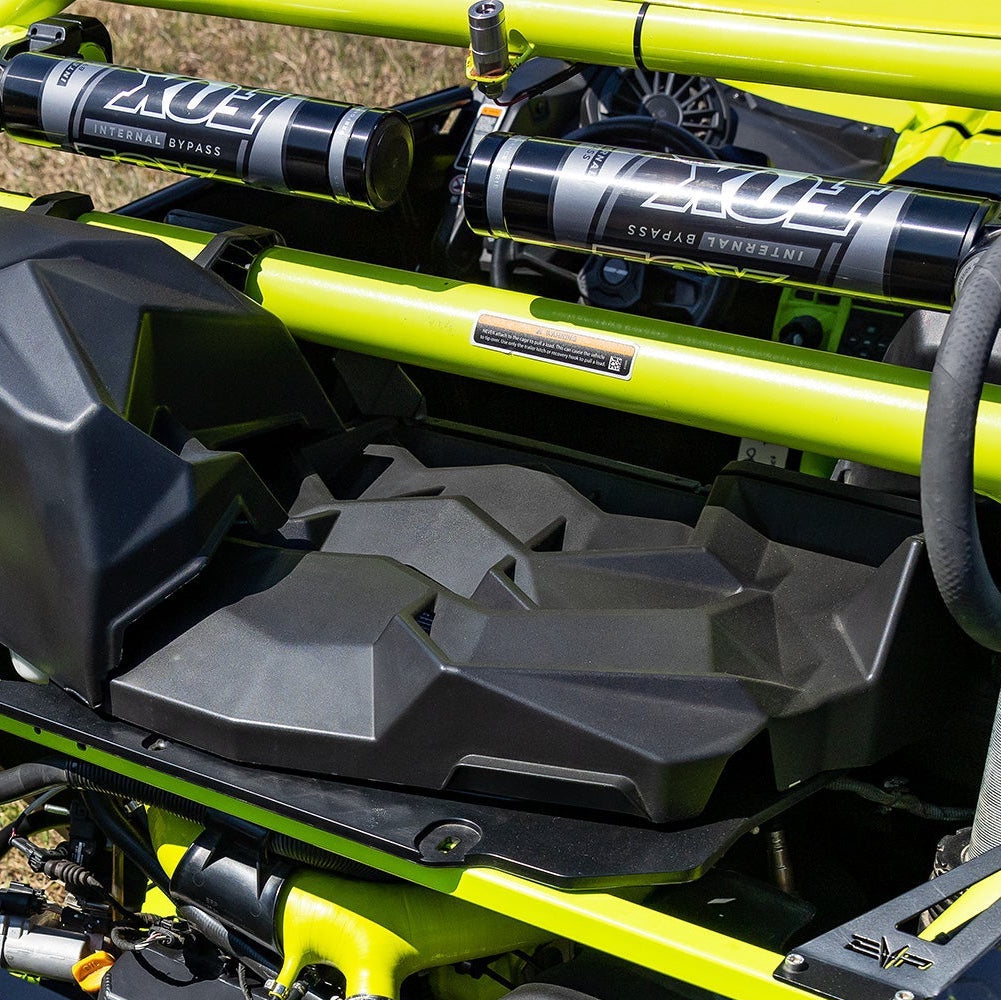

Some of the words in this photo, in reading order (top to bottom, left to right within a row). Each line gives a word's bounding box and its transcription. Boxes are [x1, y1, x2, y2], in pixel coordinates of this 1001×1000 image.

[93, 124, 162, 146] INTERNAL
[168, 137, 222, 157] BYPASS
[627, 224, 696, 244] BYPASS
[707, 236, 804, 261] INTERNAL
